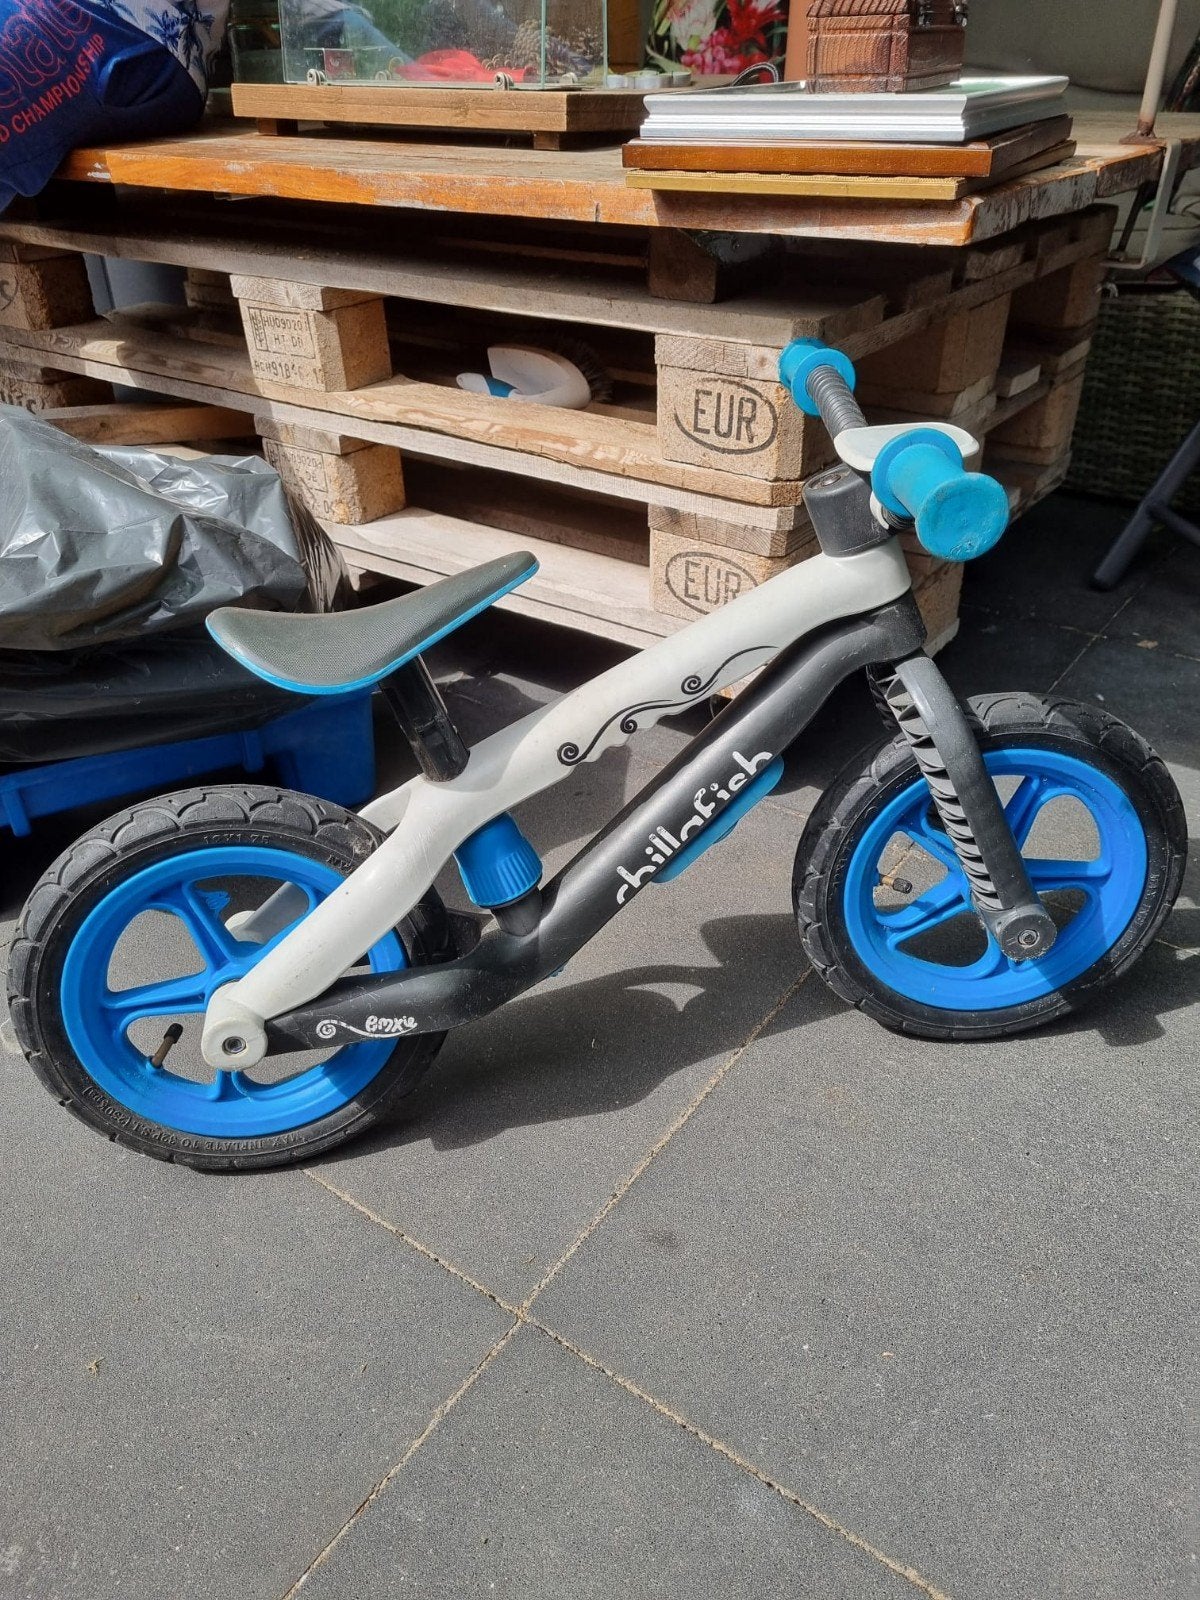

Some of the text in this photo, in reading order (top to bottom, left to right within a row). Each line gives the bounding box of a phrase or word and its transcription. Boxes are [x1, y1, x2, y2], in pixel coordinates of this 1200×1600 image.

[11, 33, 105, 134] CHAMPIONSHIP
[692, 388, 758, 444] EUR
[684, 559, 742, 606] EUR
[181, 1137, 200, 1149] TO
[205, 1138, 265, 1151] INFLATE
